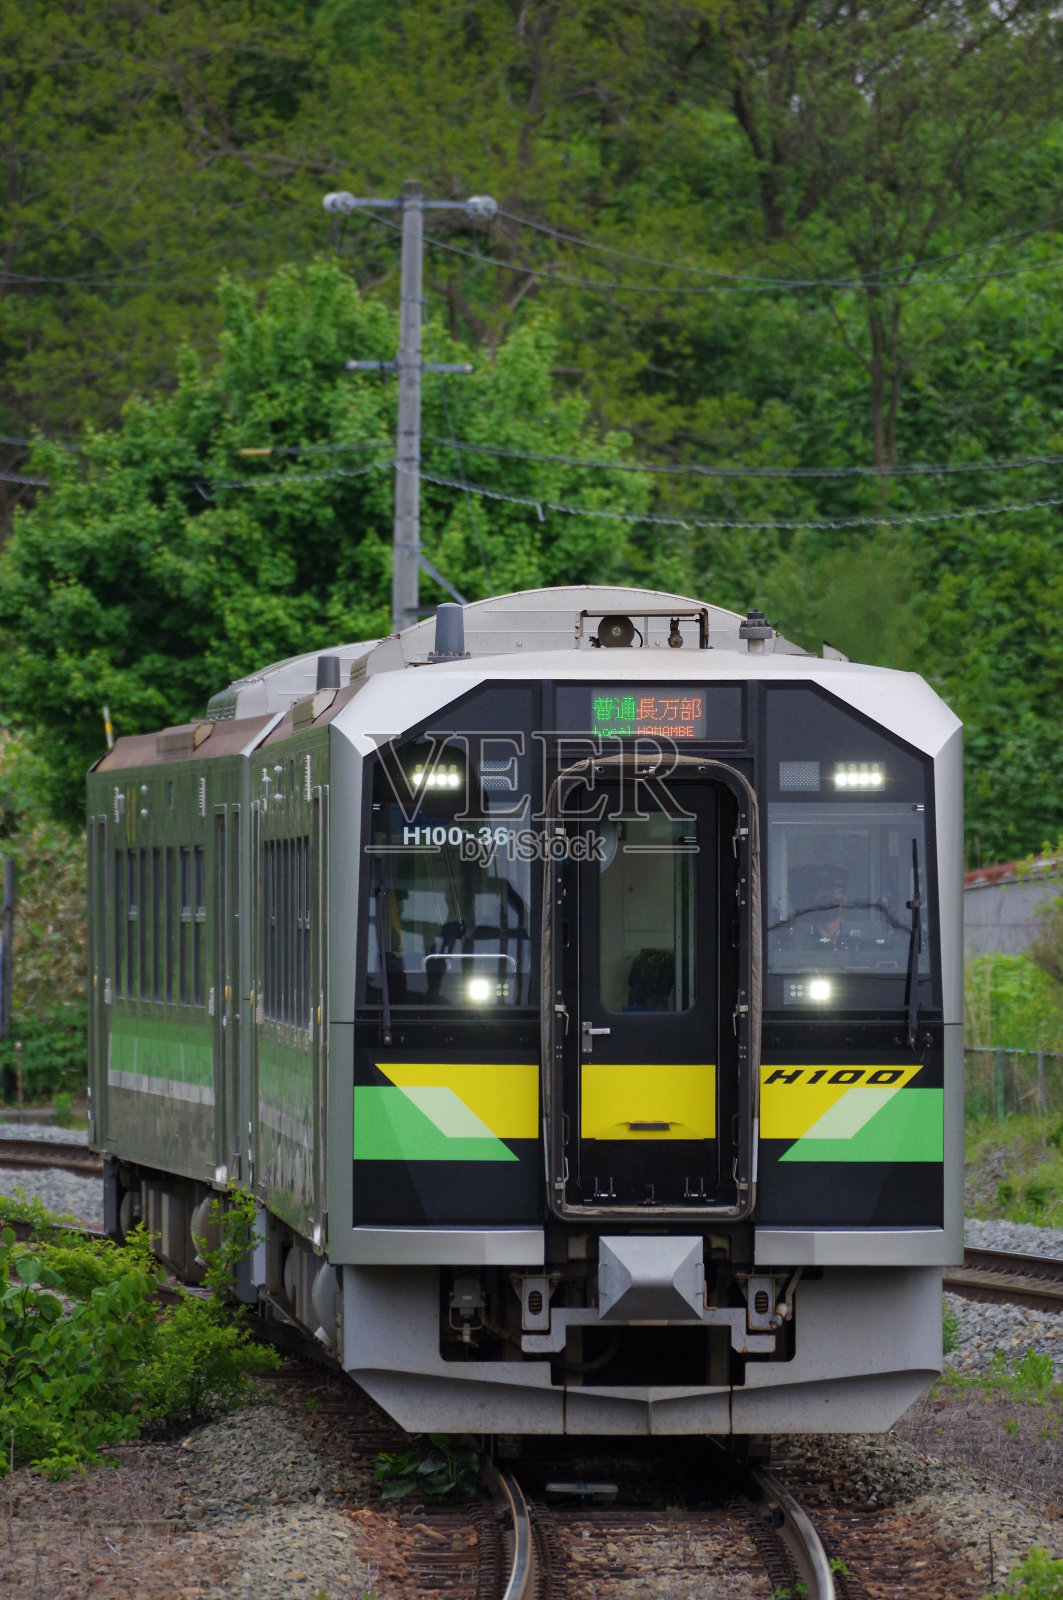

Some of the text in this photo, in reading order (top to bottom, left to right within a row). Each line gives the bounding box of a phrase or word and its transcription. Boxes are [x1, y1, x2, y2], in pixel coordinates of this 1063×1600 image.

[593, 725, 632, 737] Local
[403, 826, 508, 845] H100-36
[763, 1069, 905, 1085] H100
